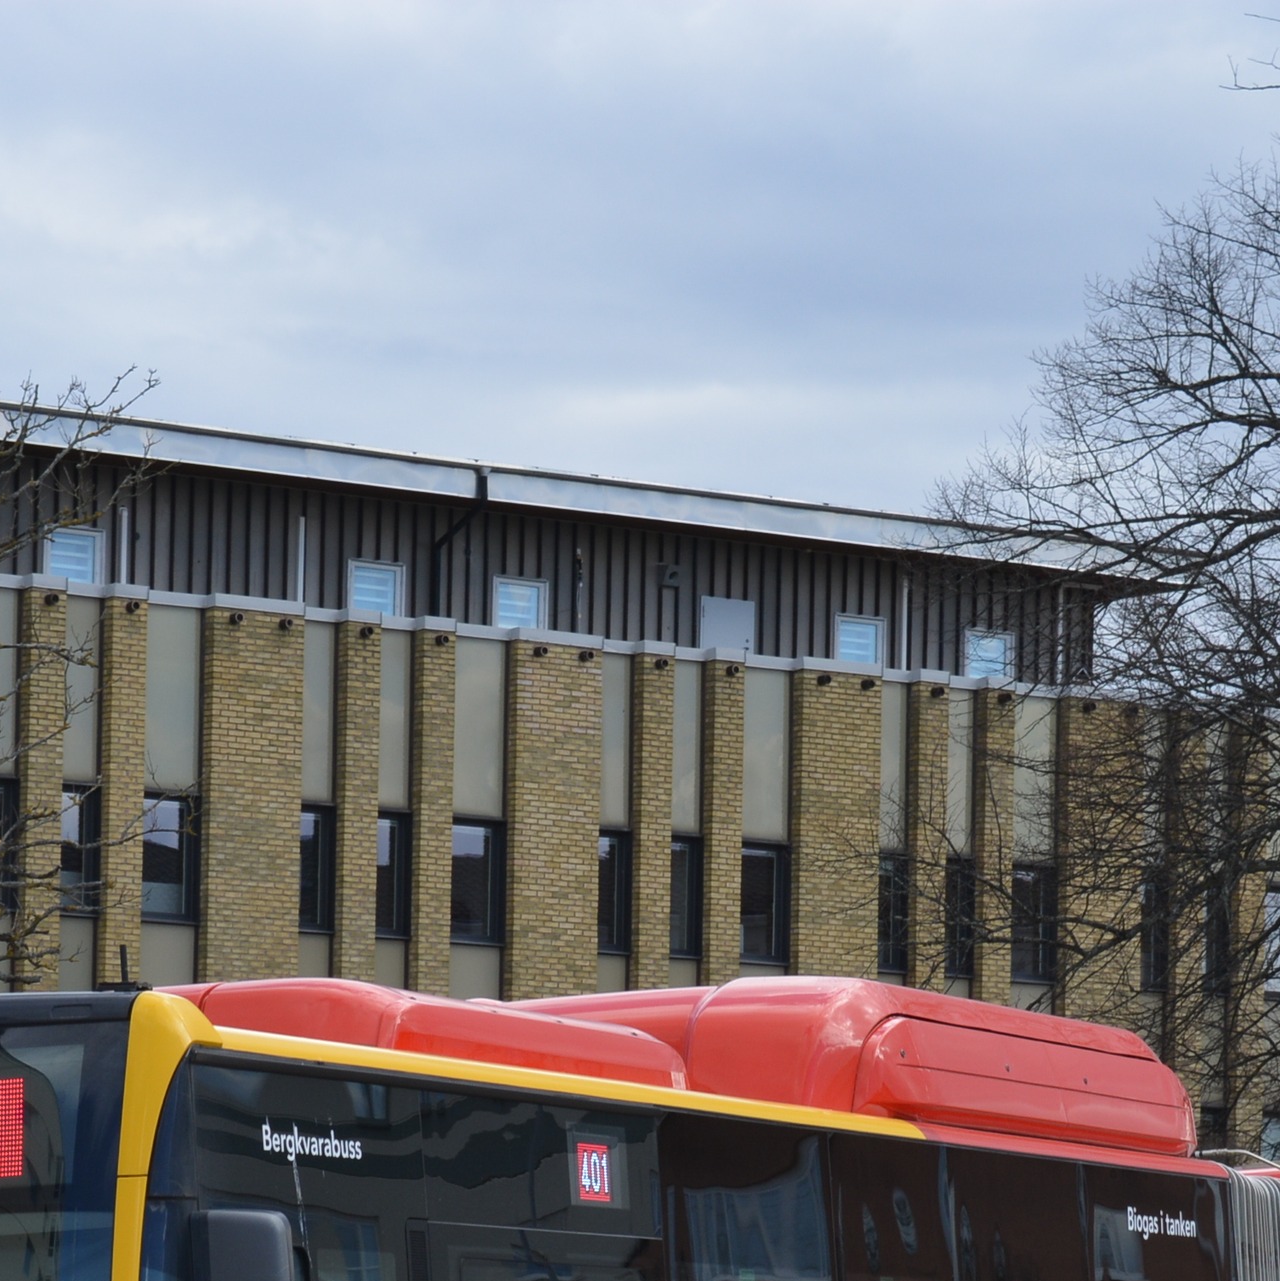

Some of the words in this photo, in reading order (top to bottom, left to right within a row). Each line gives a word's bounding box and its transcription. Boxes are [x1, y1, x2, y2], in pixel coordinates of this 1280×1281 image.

[261, 1123, 363, 1161] Bergkvarabuss
[581, 1151, 610, 1193] 401
[1127, 1206, 1159, 1241] Biogas
[1159, 1209, 1164, 1235] i
[1165, 1211, 1197, 1238] tanken
